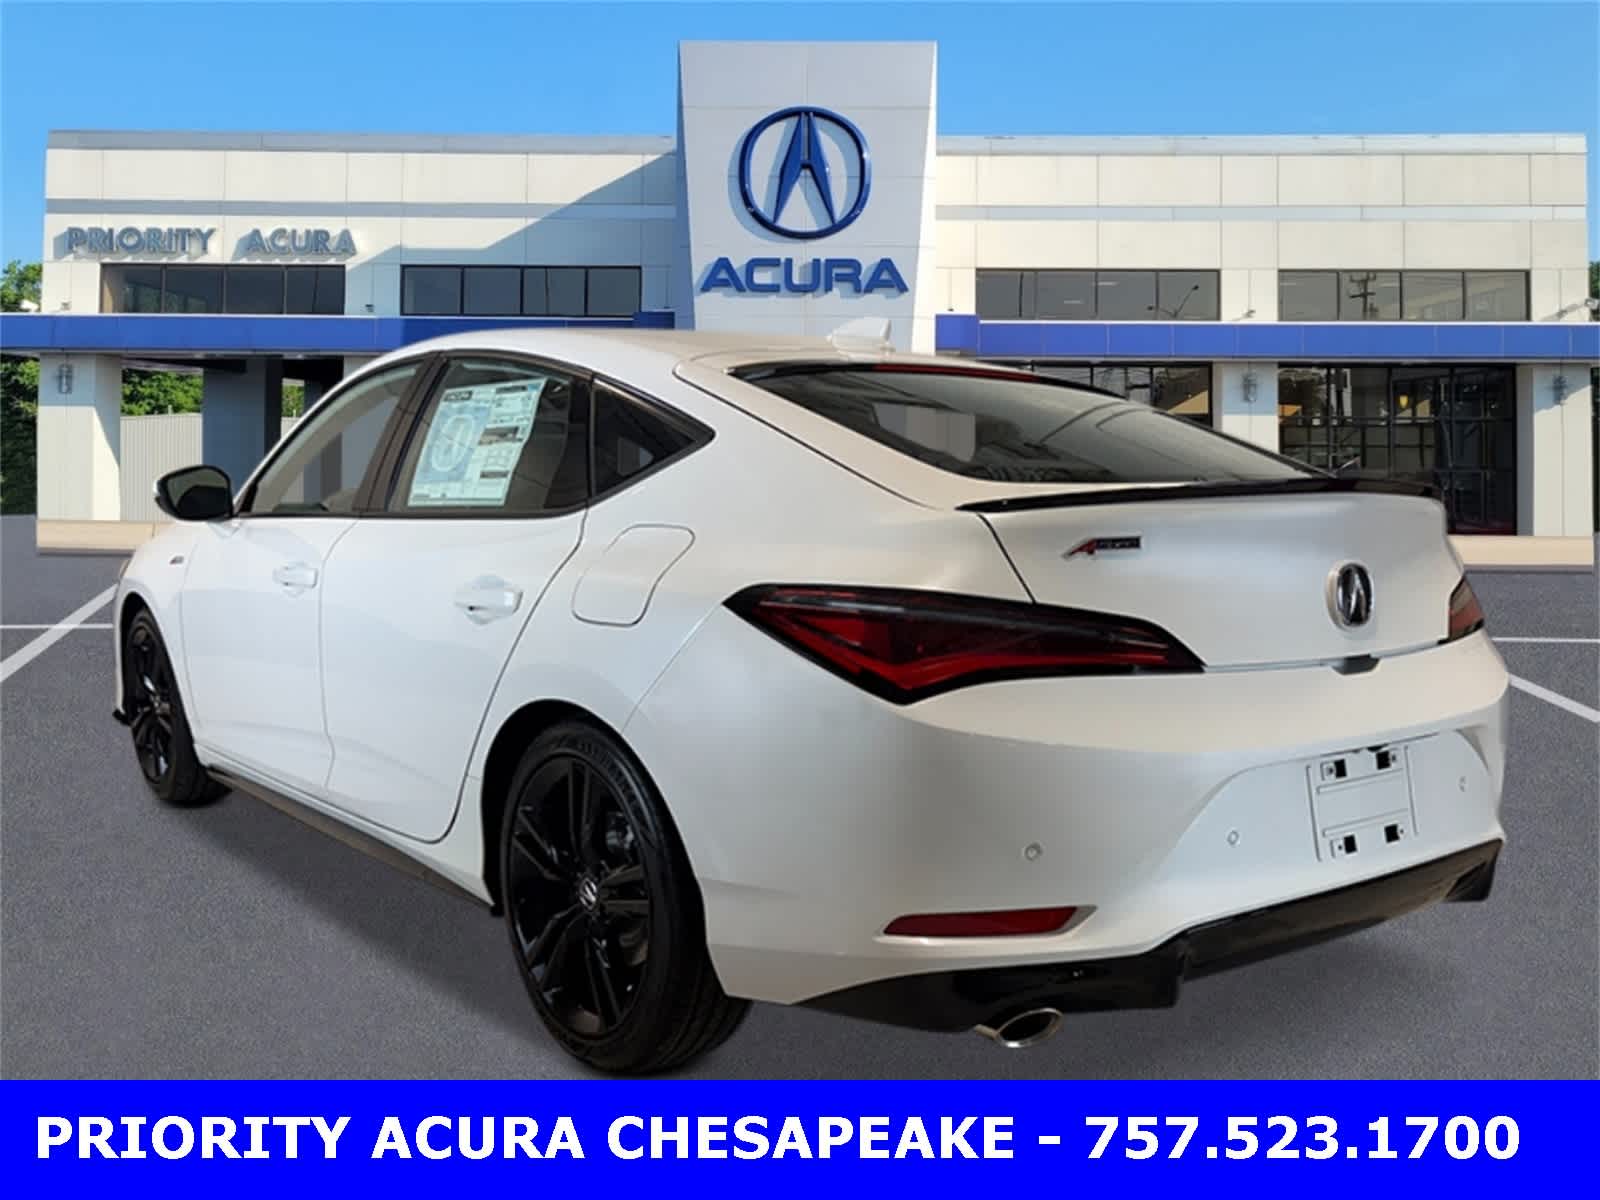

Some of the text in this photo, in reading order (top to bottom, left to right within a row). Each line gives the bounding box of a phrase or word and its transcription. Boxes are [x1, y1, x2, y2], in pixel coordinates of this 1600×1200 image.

[65, 226, 357, 256] PRIORITY ACURA
[700, 256, 909, 294] ACURA
